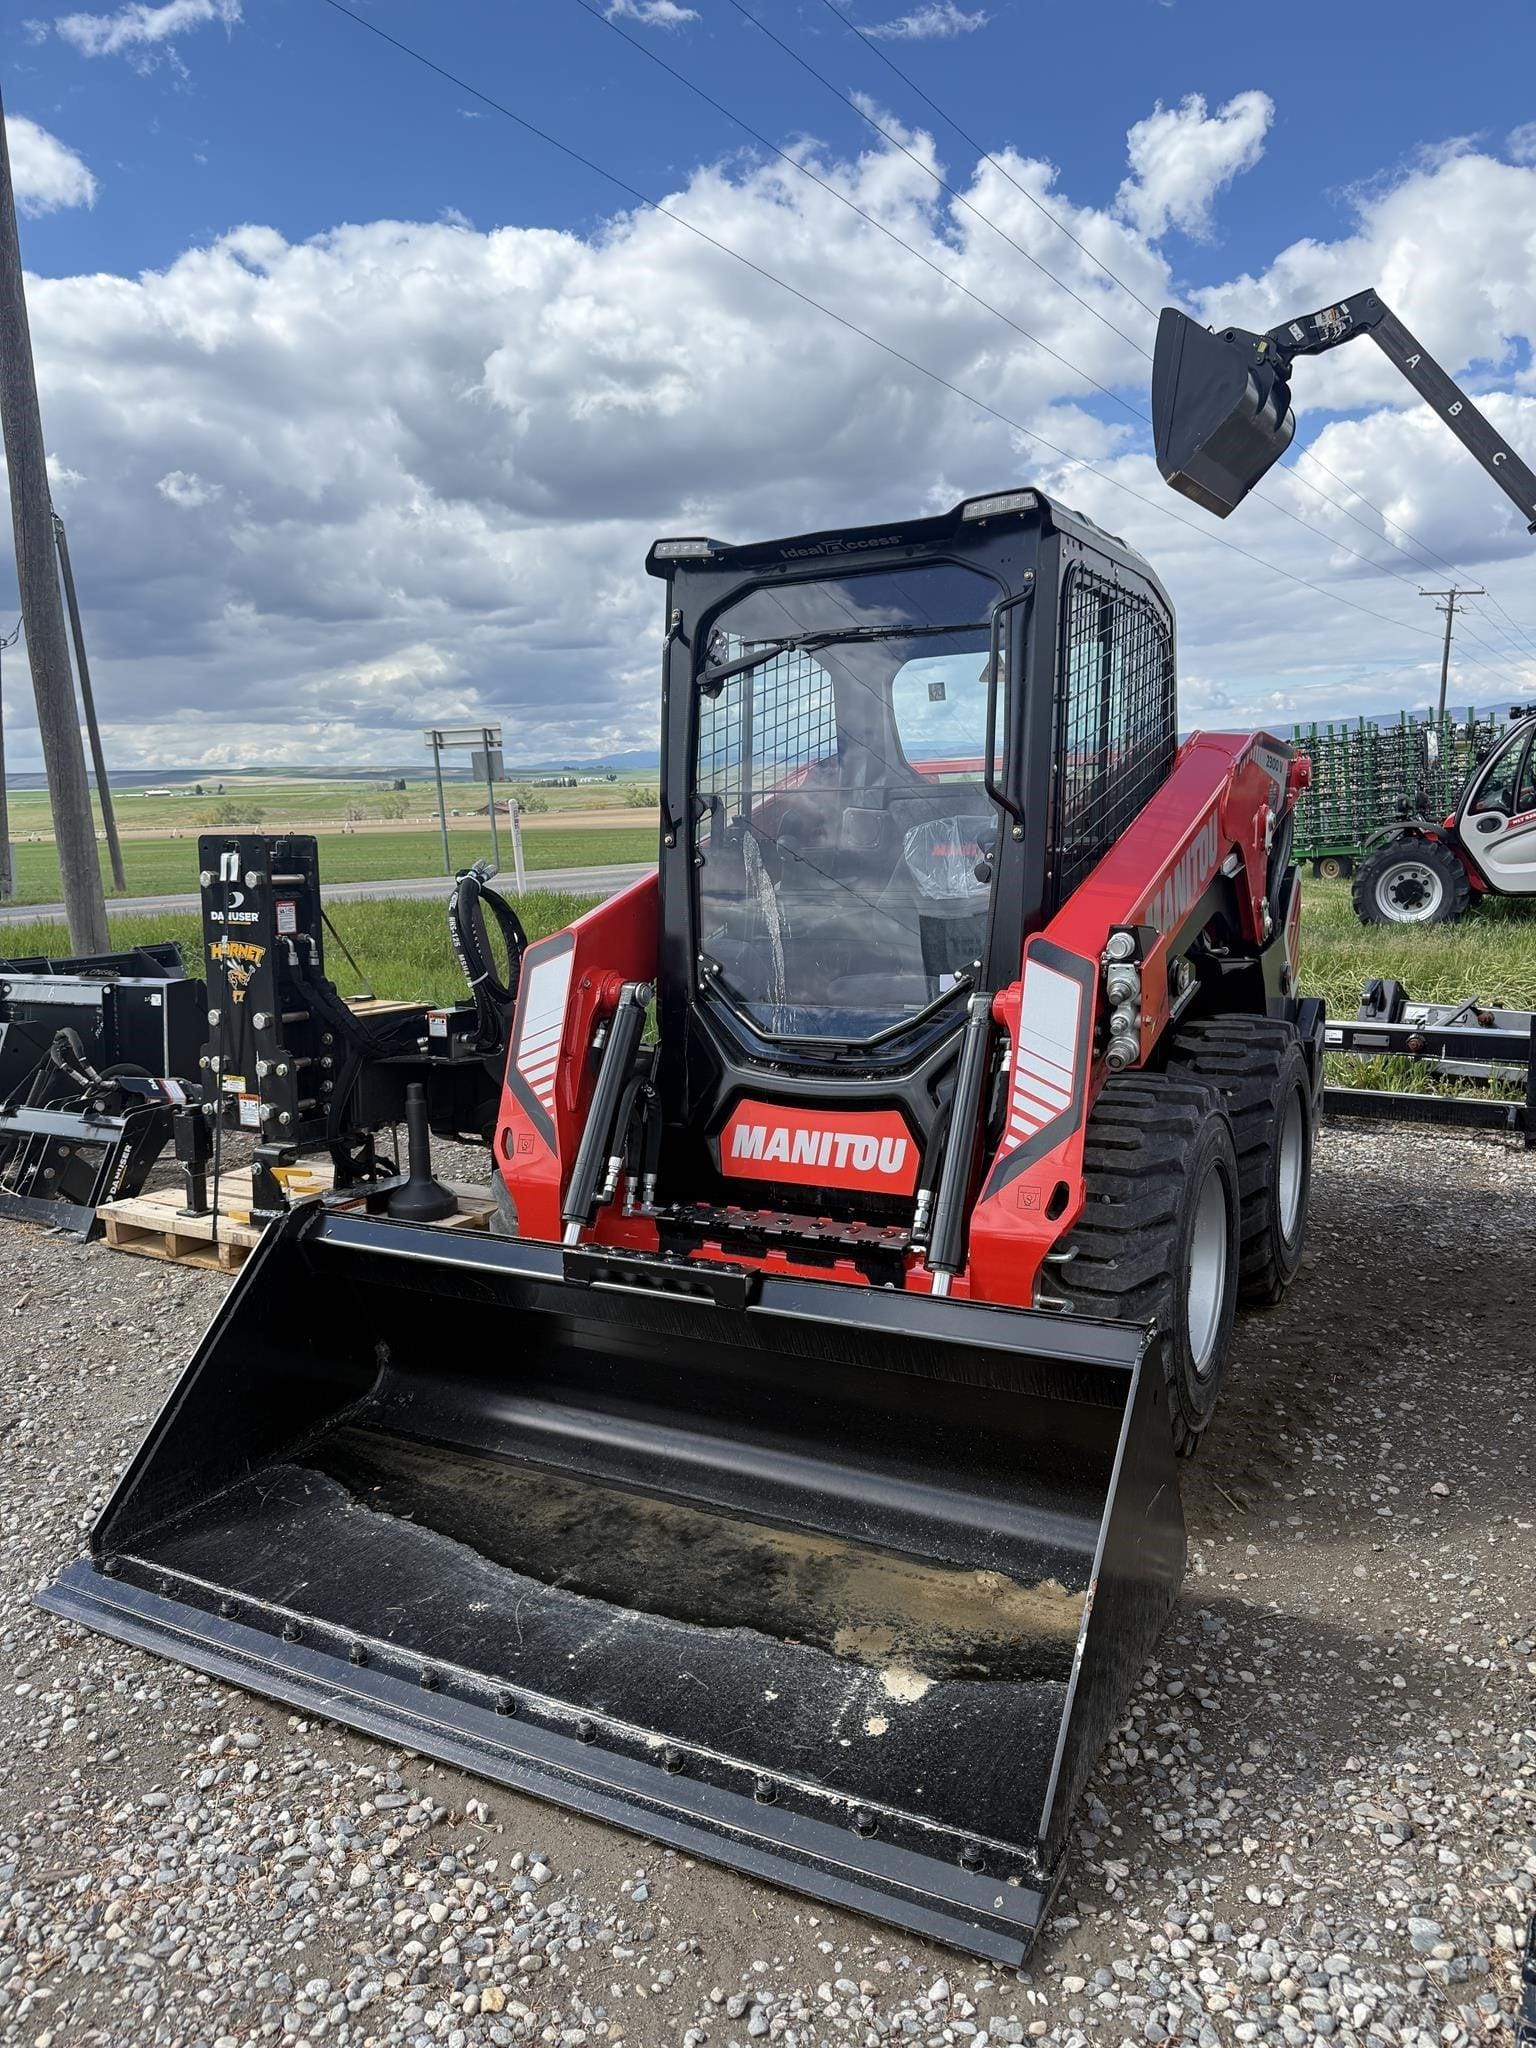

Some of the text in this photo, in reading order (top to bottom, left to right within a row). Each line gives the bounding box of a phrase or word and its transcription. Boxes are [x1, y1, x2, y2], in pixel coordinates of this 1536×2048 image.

[1406, 354, 1421, 368] A
[1448, 401, 1463, 416] B
[1492, 452, 1507, 466] C
[1145, 808, 1218, 939] MANITOU
[731, 1124, 907, 1174] MANITOU
[109, 1143, 133, 1196] DANUSER
